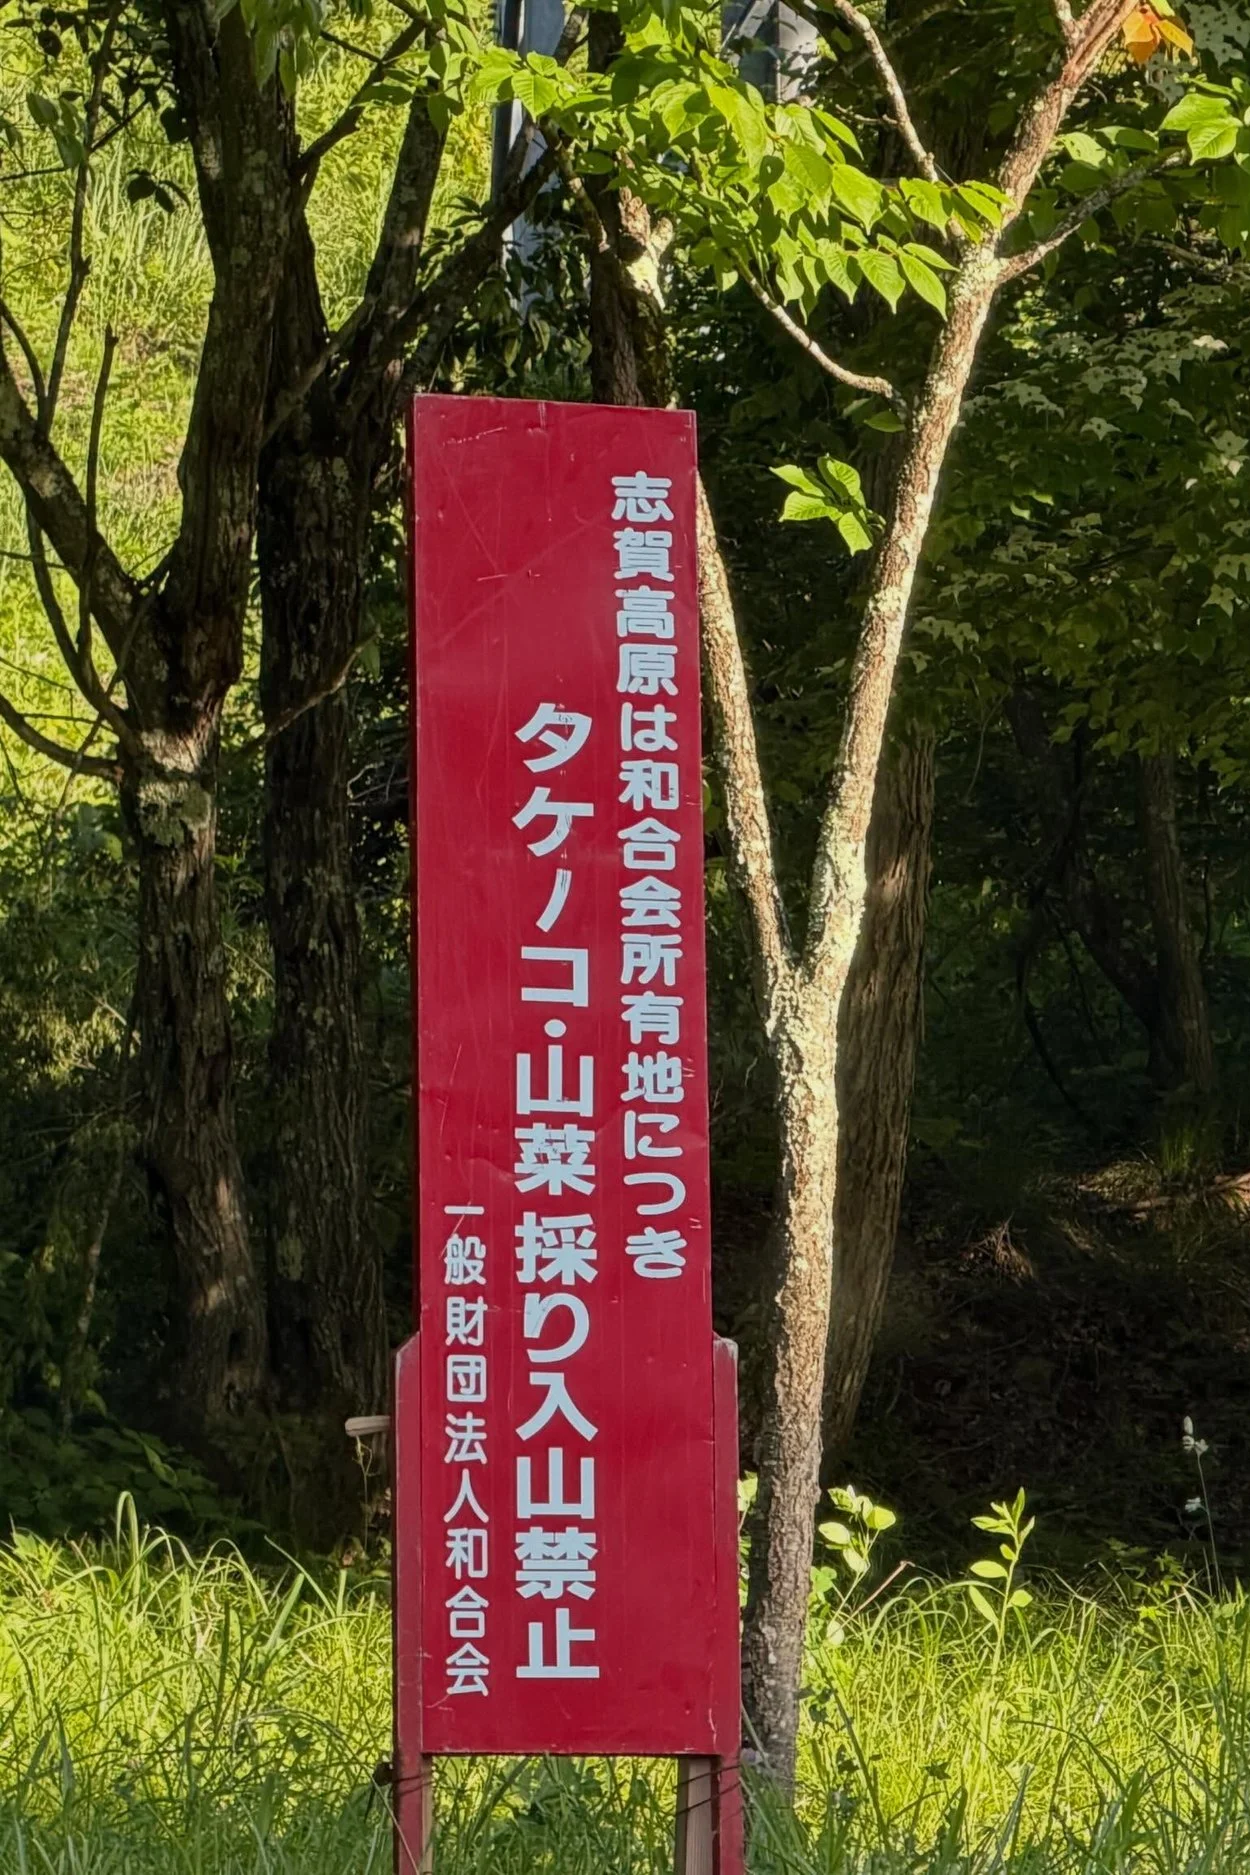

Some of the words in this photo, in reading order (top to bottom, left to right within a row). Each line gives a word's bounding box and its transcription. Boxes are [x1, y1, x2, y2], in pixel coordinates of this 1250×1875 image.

[511, 702, 600, 1679] タケノコ・山菜採り入山禁止
[611, 470, 688, 1279] 志賀高原は和合会所有地につき
[443, 1205, 490, 1697] 一般財団法人和合会
